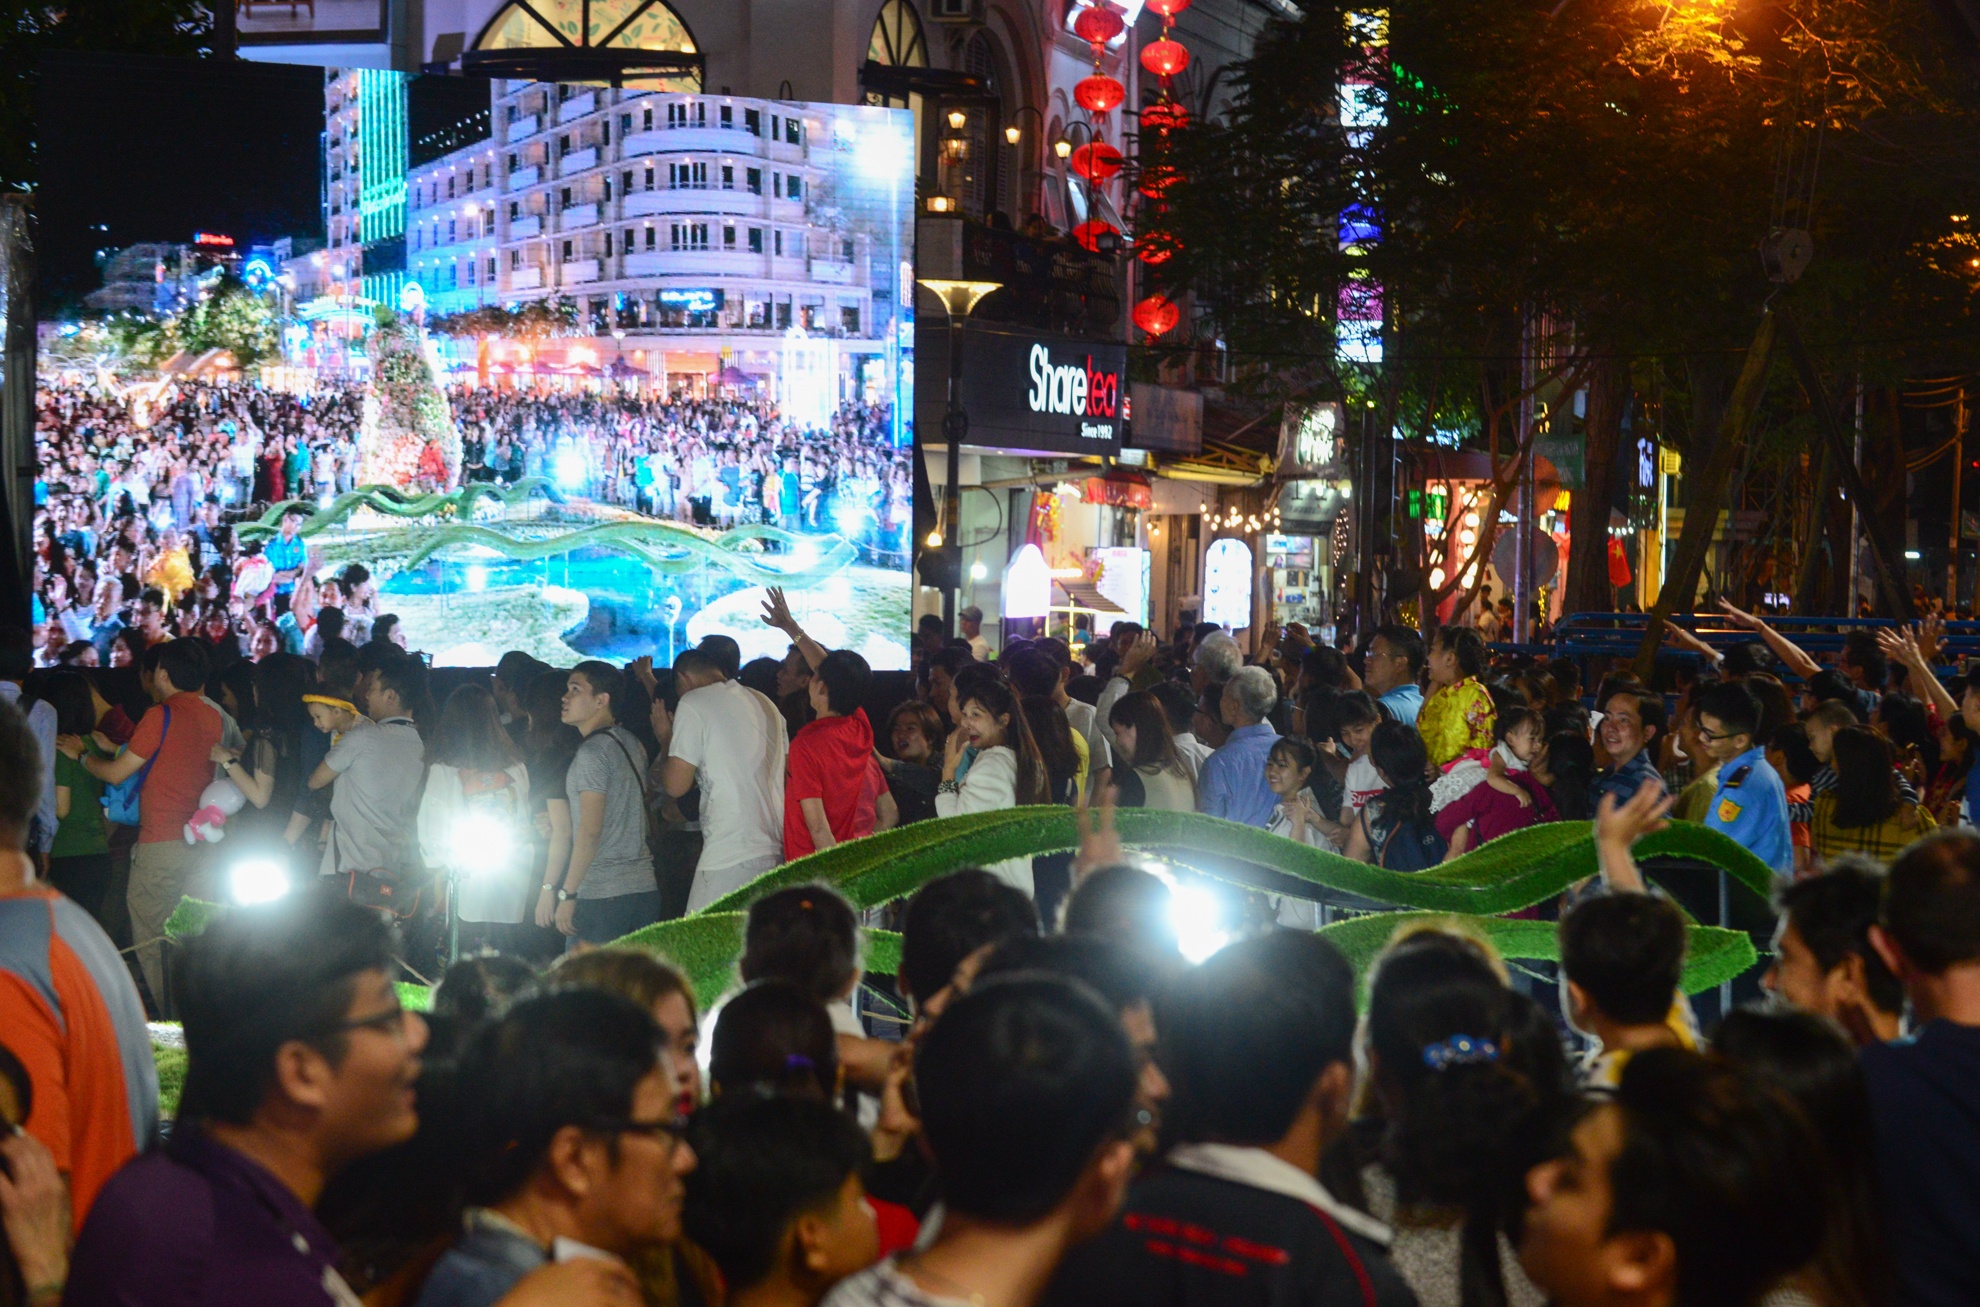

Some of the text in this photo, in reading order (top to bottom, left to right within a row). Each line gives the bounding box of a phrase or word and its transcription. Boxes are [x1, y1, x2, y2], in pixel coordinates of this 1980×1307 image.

[1029, 343, 1117, 418] Sharetea
[1081, 421, 1113, 439] Since 1992
